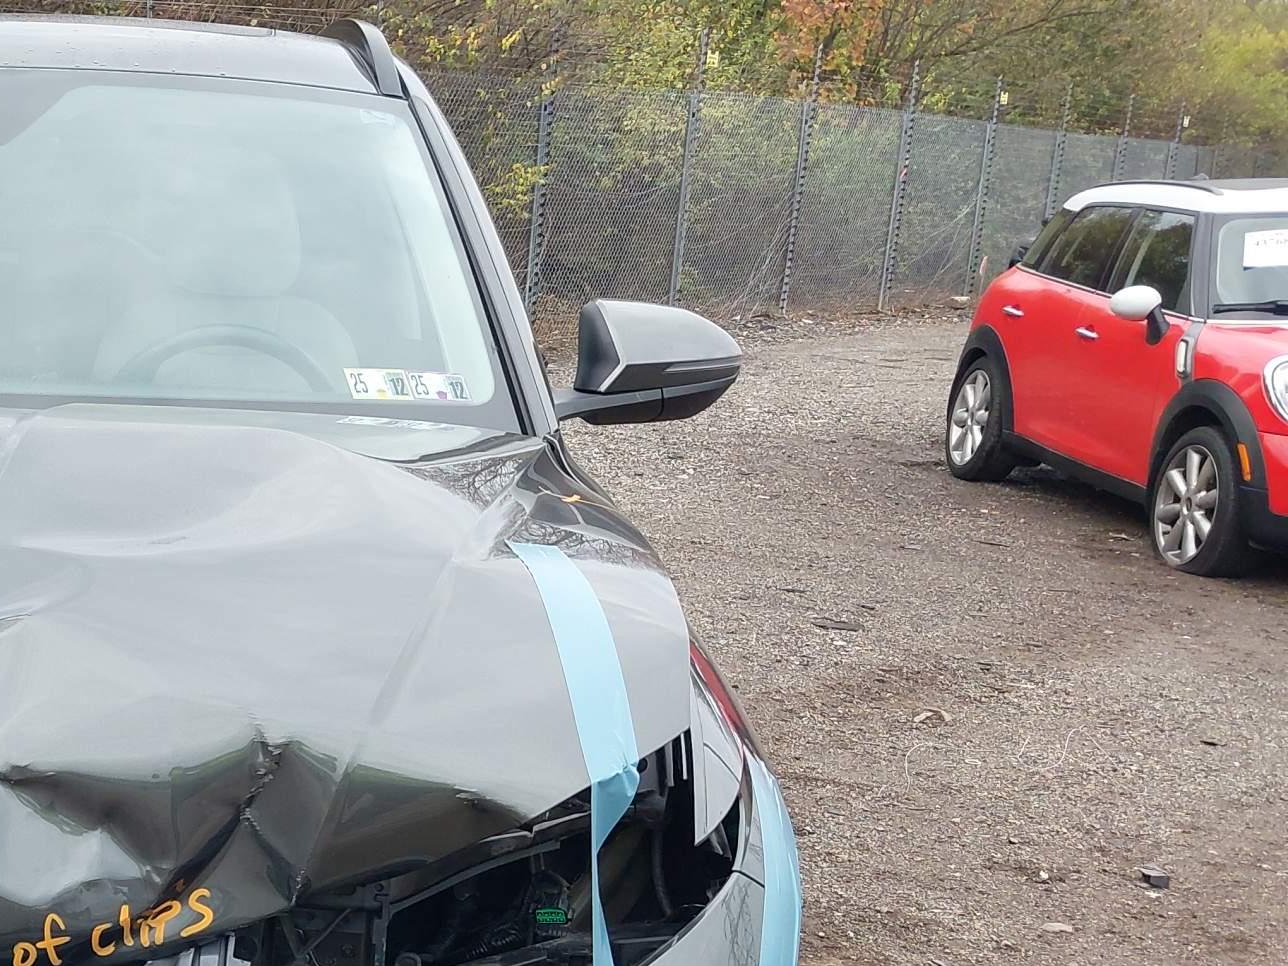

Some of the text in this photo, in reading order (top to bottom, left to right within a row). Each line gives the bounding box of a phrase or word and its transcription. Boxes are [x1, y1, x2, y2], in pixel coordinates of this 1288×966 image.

[350, 372, 409, 396] 25 12
[410, 374, 469, 400] 25 12
